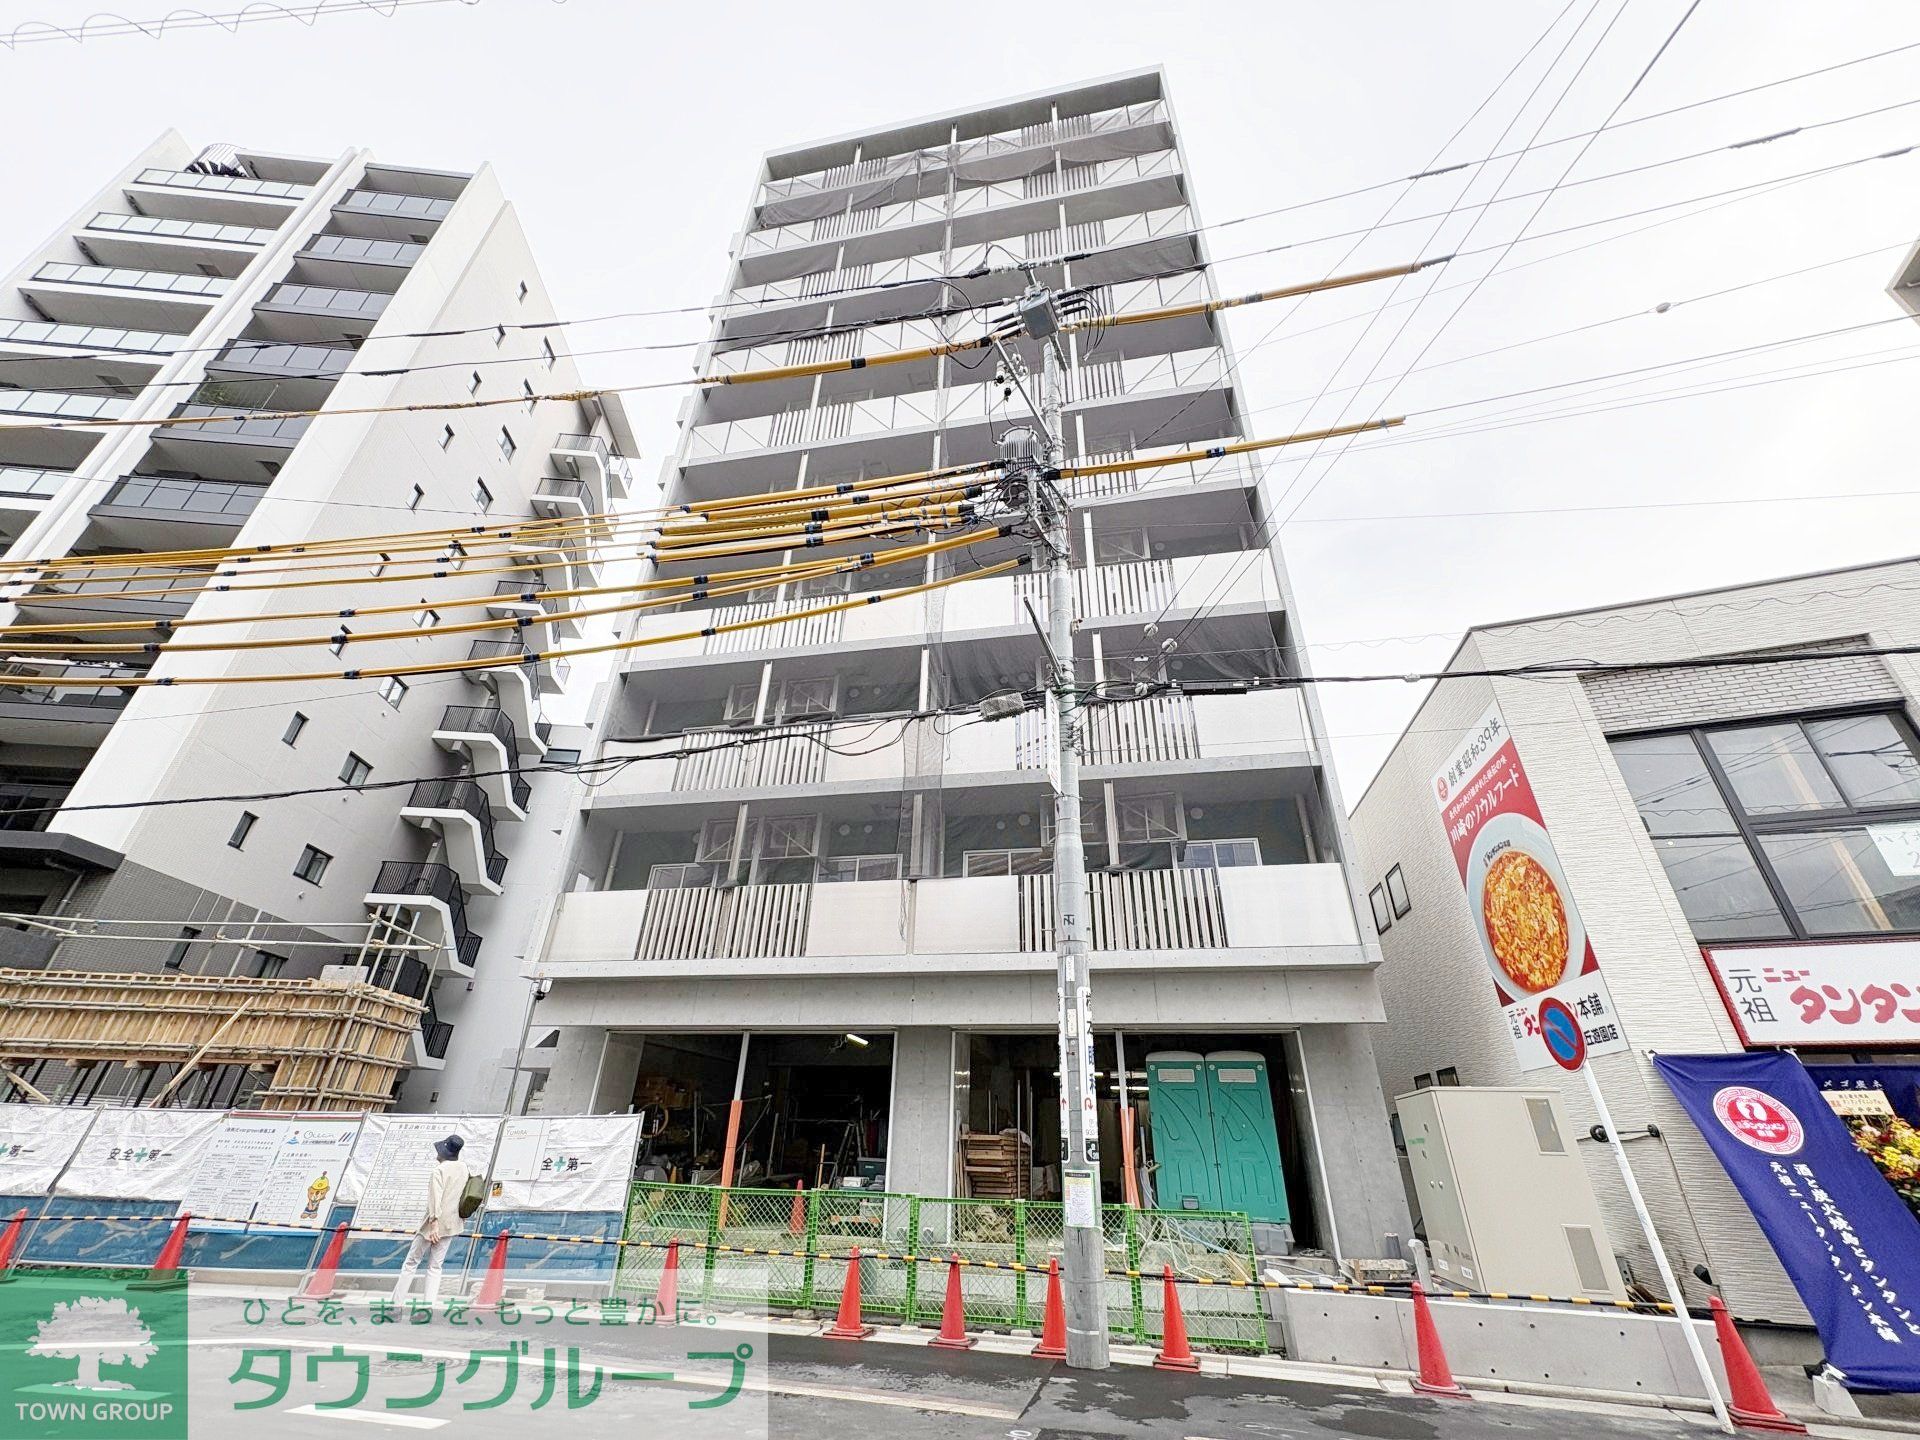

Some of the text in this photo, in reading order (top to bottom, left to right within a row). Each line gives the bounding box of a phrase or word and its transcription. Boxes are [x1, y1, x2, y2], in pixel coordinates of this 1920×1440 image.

[1448, 717, 1501, 786] 創業昭和39年
[1450, 763, 1520, 845] 川崎のソウルフード
[1763, 967, 1810, 983] ニュー
[1728, 968, 1778, 1024] 元祖
[6, 1145, 35, 1157] 第一
[107, 1148, 172, 1161] 安全 第一
[541, 1157, 592, 1171] 全 第一
